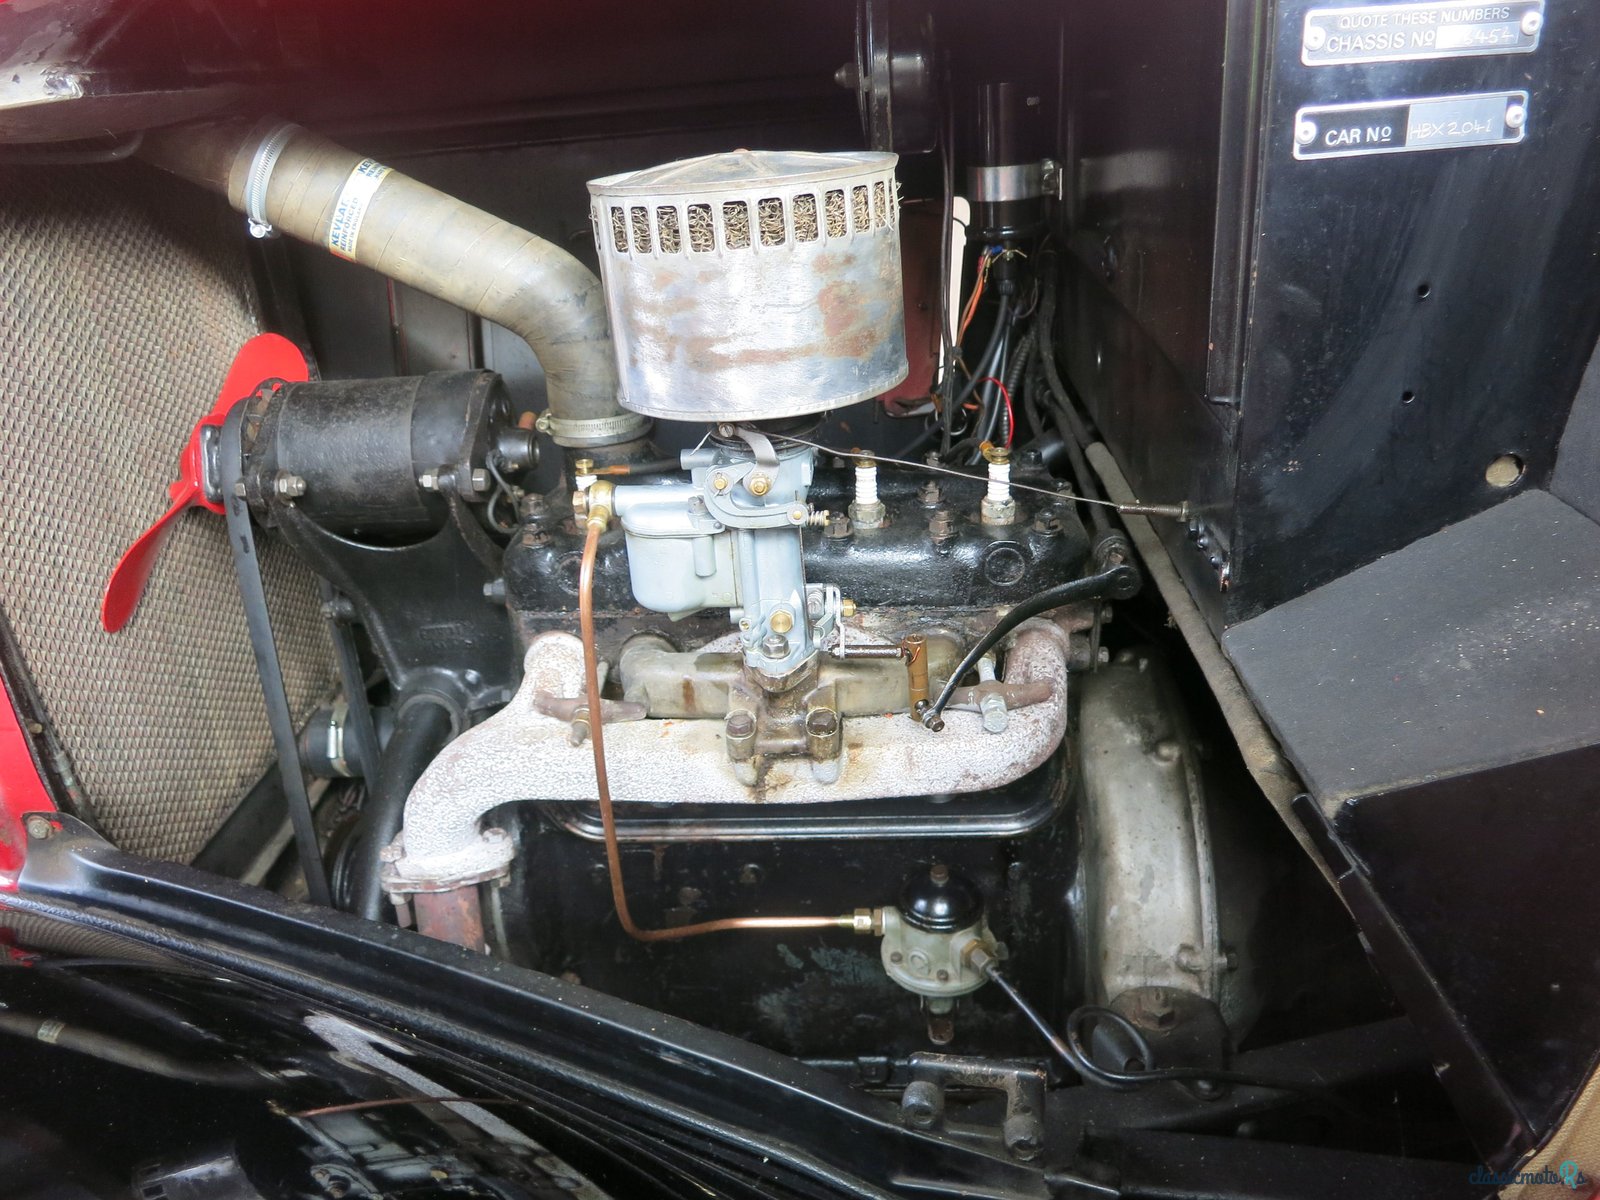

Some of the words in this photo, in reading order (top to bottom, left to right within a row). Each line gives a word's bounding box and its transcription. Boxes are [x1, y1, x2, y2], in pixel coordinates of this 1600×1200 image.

[1339, 14, 1389, 29] QUOTE
[1393, 10, 1437, 25] THESE
[1441, 7, 1510, 23] NUMBERS
[1326, 34, 1406, 52] CHASSIS
[1325, 129, 1361, 146] CAR
